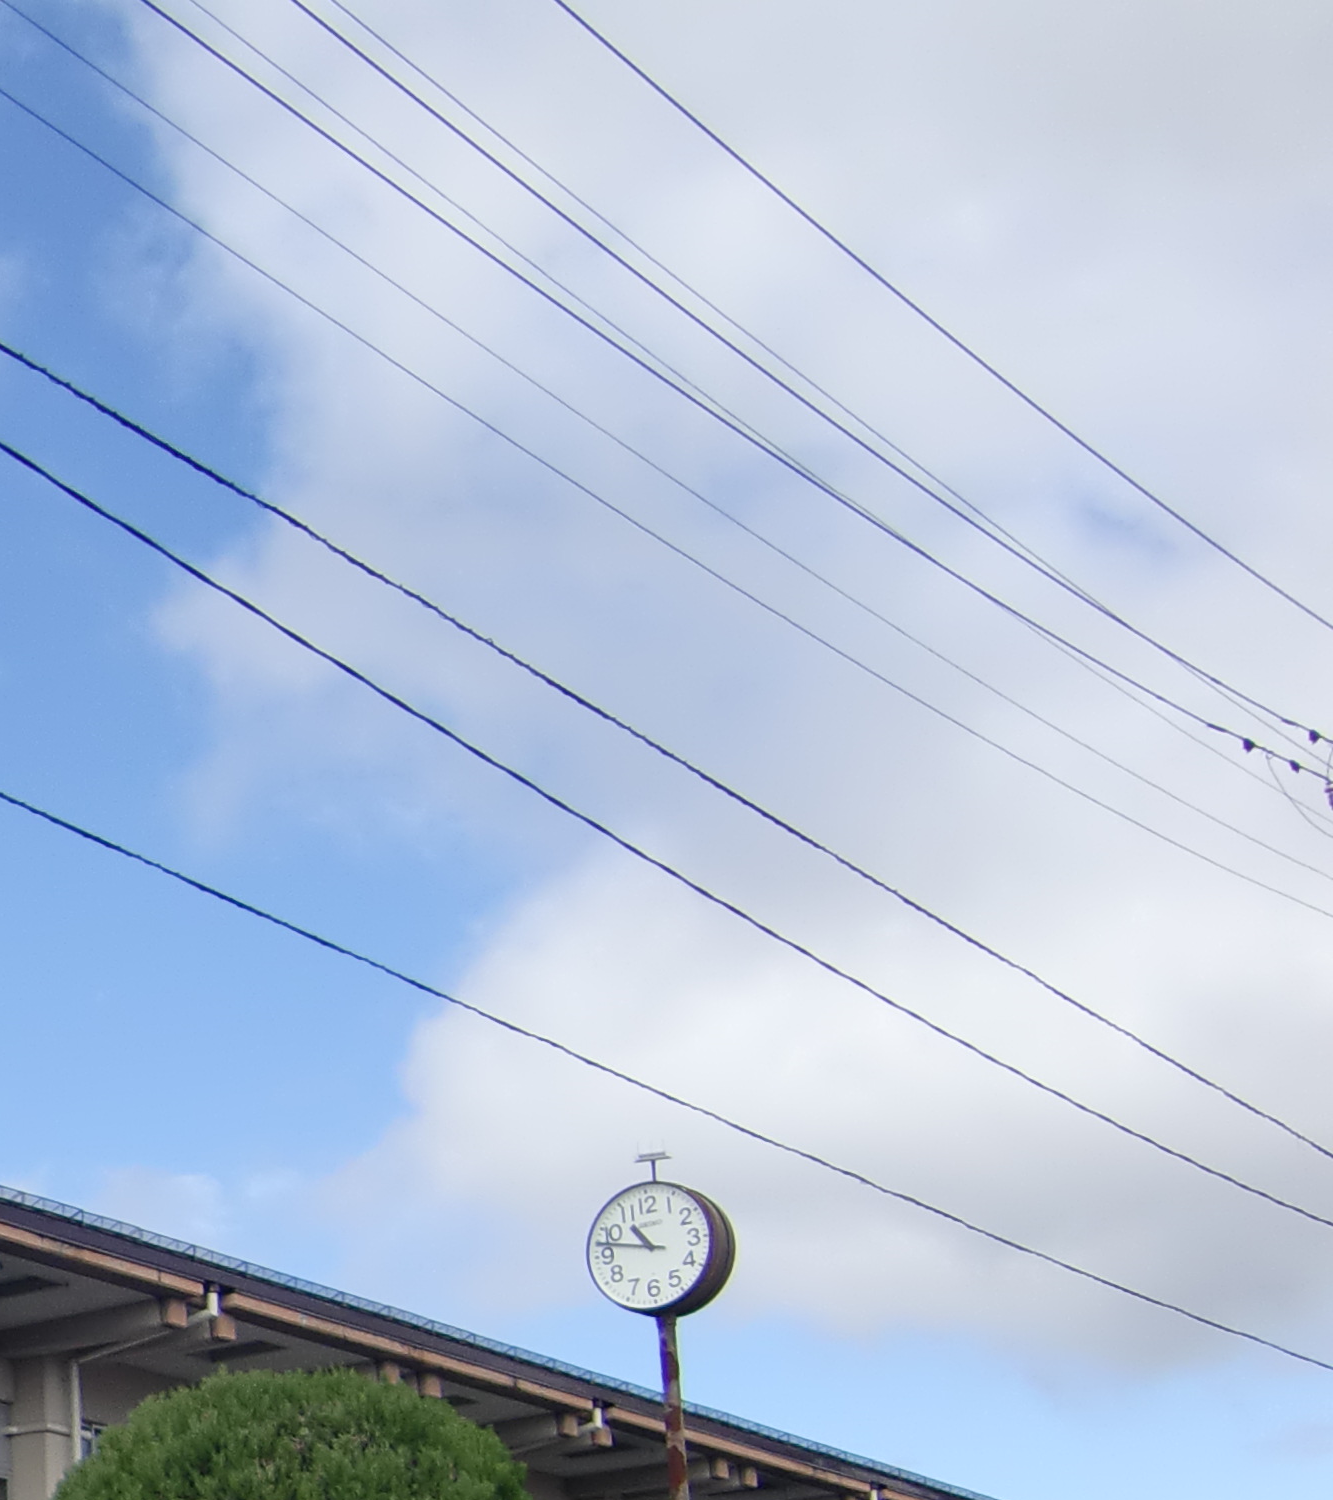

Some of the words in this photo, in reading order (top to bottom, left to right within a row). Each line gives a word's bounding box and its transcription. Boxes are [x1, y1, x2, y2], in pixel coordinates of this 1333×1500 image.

[620, 1204, 635, 1223] 11
[638, 1195, 657, 1215] 12
[666, 1196, 672, 1214] 1
[679, 1207, 692, 1225] 2
[604, 1224, 623, 1244] 10
[687, 1228, 701, 1246] 3
[601, 1247, 614, 1265] 9
[682, 1250, 695, 1267] 4
[610, 1265, 623, 1283] 8
[668, 1270, 681, 1288] 5
[627, 1278, 640, 1296] 7
[647, 1279, 661, 1297] 6
